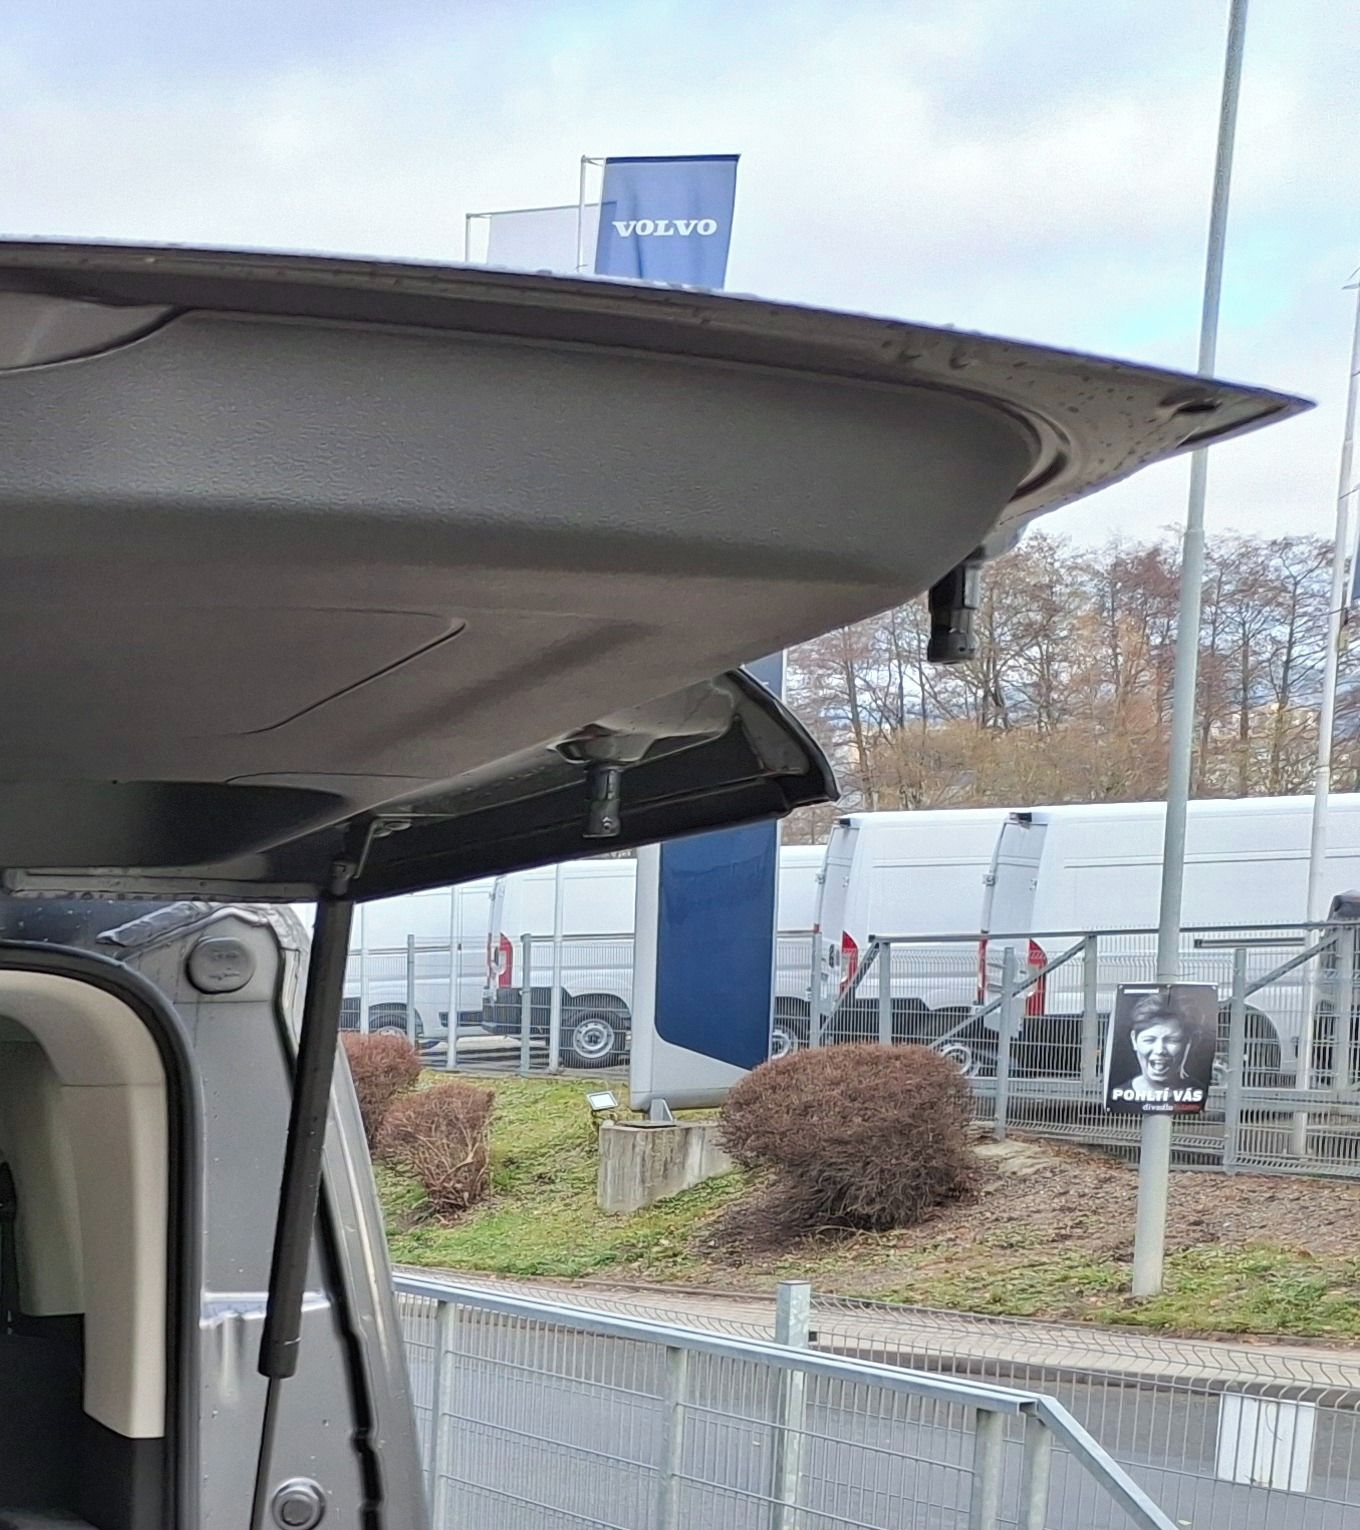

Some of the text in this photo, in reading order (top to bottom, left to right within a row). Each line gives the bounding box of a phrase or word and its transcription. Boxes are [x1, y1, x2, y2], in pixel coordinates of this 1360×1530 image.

[612, 219, 718, 237] VOLVO
[1112, 1087, 1204, 1102] POHLTÍ VÁS
